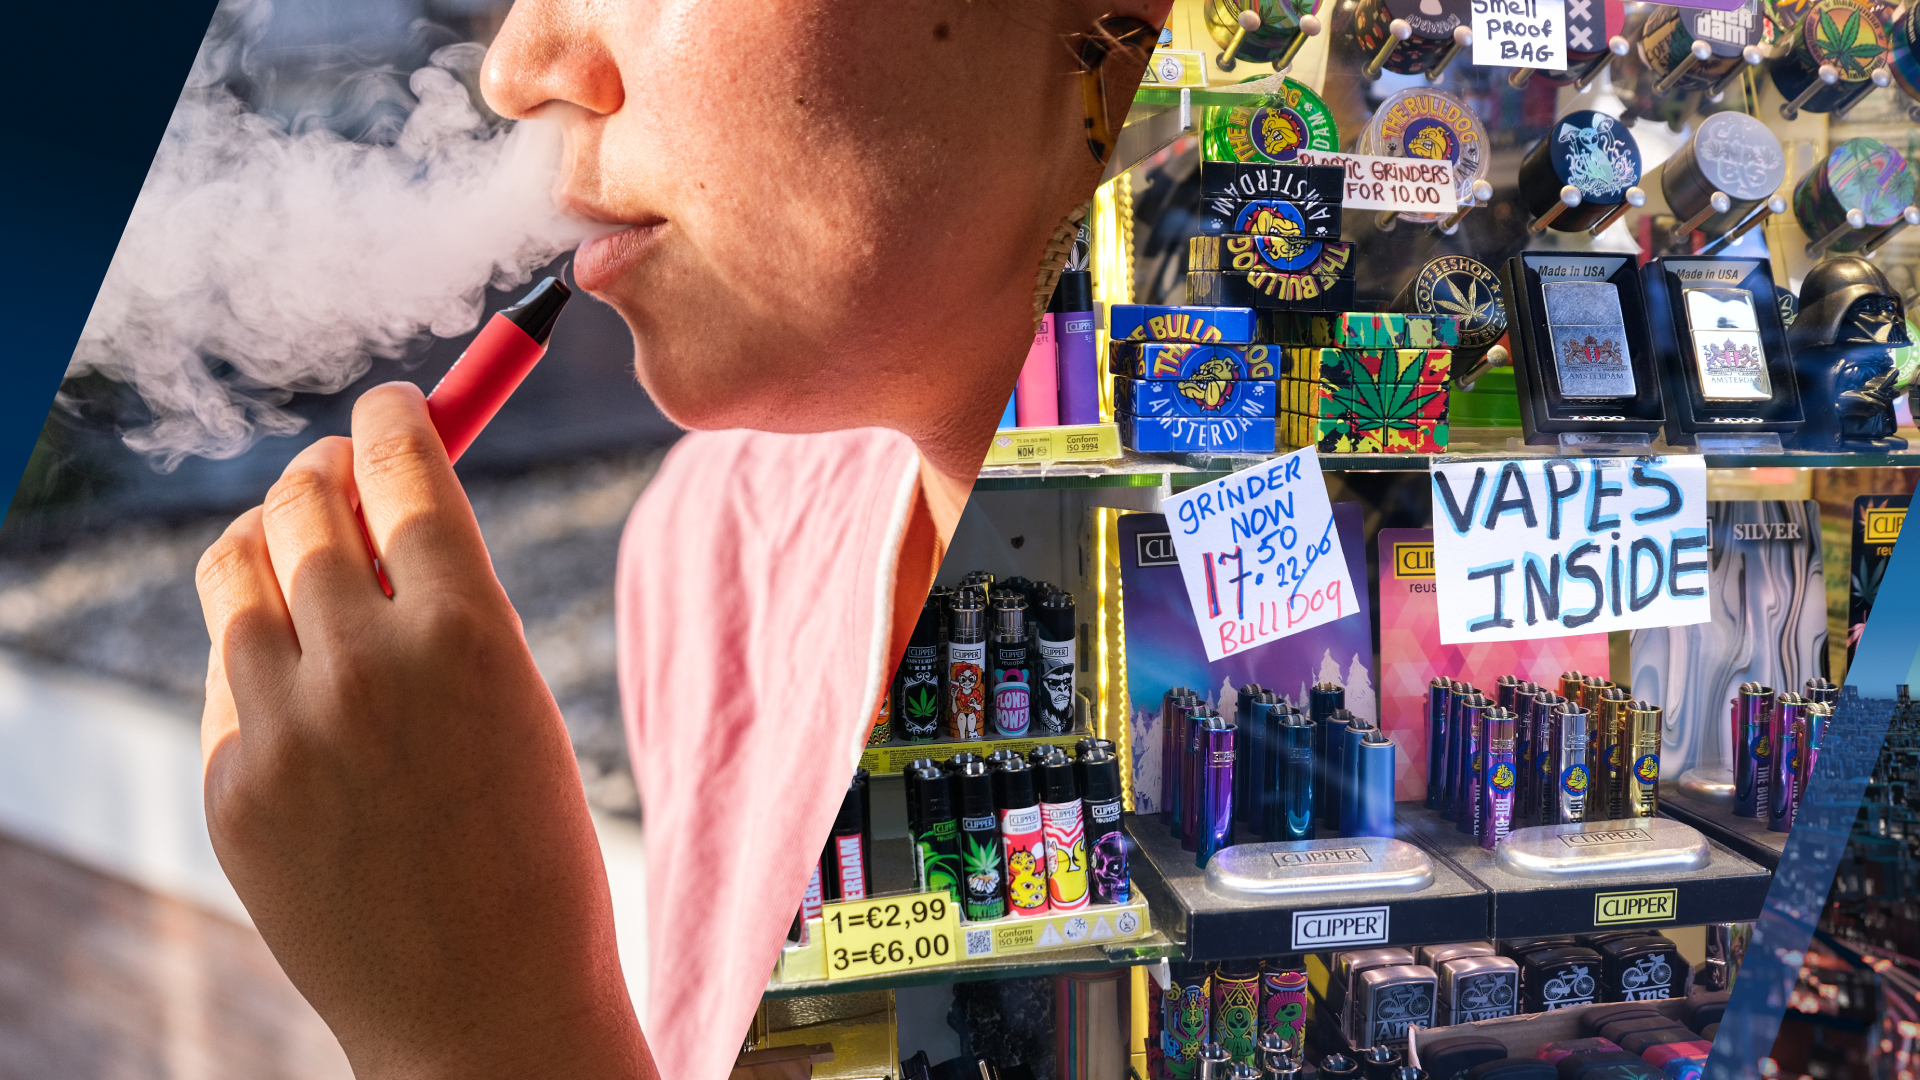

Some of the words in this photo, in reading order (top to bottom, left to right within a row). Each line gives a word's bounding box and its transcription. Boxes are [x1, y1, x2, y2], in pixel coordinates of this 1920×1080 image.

[1500, 40, 1554, 62] BAG
[1382, 104, 1409, 139] THE
[1402, 95, 1479, 143] BULLDOG
[1211, 169, 1331, 220] AMSTERDAM
[1346, 181, 1385, 202] FOR
[1389, 184, 1441, 204] 10.00
[1538, 265, 1566, 277] Made
[1569, 266, 1580, 277] in
[1583, 265, 1605, 278] USA
[1676, 268, 1703, 280] Made
[1705, 268, 1716, 280] in
[1718, 269, 1738, 281] USA
[1419, 258, 1491, 312] COFFEESHOP
[1069, 321, 1094, 331] CLIPPE
[1569, 372, 1623, 380] AMSTERDAM
[1711, 376, 1762, 384] AMSTERDAM
[1149, 398, 1265, 447] AMSTERDAM
[1066, 436, 1098, 444] Conform
[1017, 447, 1034, 457] NOM
[1066, 444, 1079, 452] ISO
[1081, 443, 1098, 451] 9994
[1432, 456, 1684, 541] VAPES
[1231, 491, 1294, 543] NOW
[1733, 522, 1801, 541] SILVER
[1410, 582, 1437, 593] reus
[910, 647, 935, 656] CLIPPER
[954, 649, 979, 659] CLIPPER
[1001, 650, 1025, 659] CLIPPER
[1043, 647, 1066, 656] CLIPPER
[996, 691, 1030, 709] FLOWER
[996, 708, 1030, 729] POWER
[1051, 809, 1076, 819] CLIPPER
[1094, 805, 1119, 816] CLIPPER
[965, 818, 993, 829] CLIPPER
[1012, 815, 1037, 825] CLIPPER
[936, 821, 957, 833] CLIPPE
[1568, 829, 1642, 845] CLIPPER
[1281, 849, 1358, 865] CLIPPER
[1602, 896, 1669, 917] CLIPPER
[830, 898, 946, 934] 1=€2,99
[998, 928, 1033, 938] Conform
[1302, 915, 1379, 939] CLIPPER
[999, 938, 1013, 946] ISO
[1014, 935, 1033, 945] 9994
[833, 934, 949, 971] 3=€6,00
